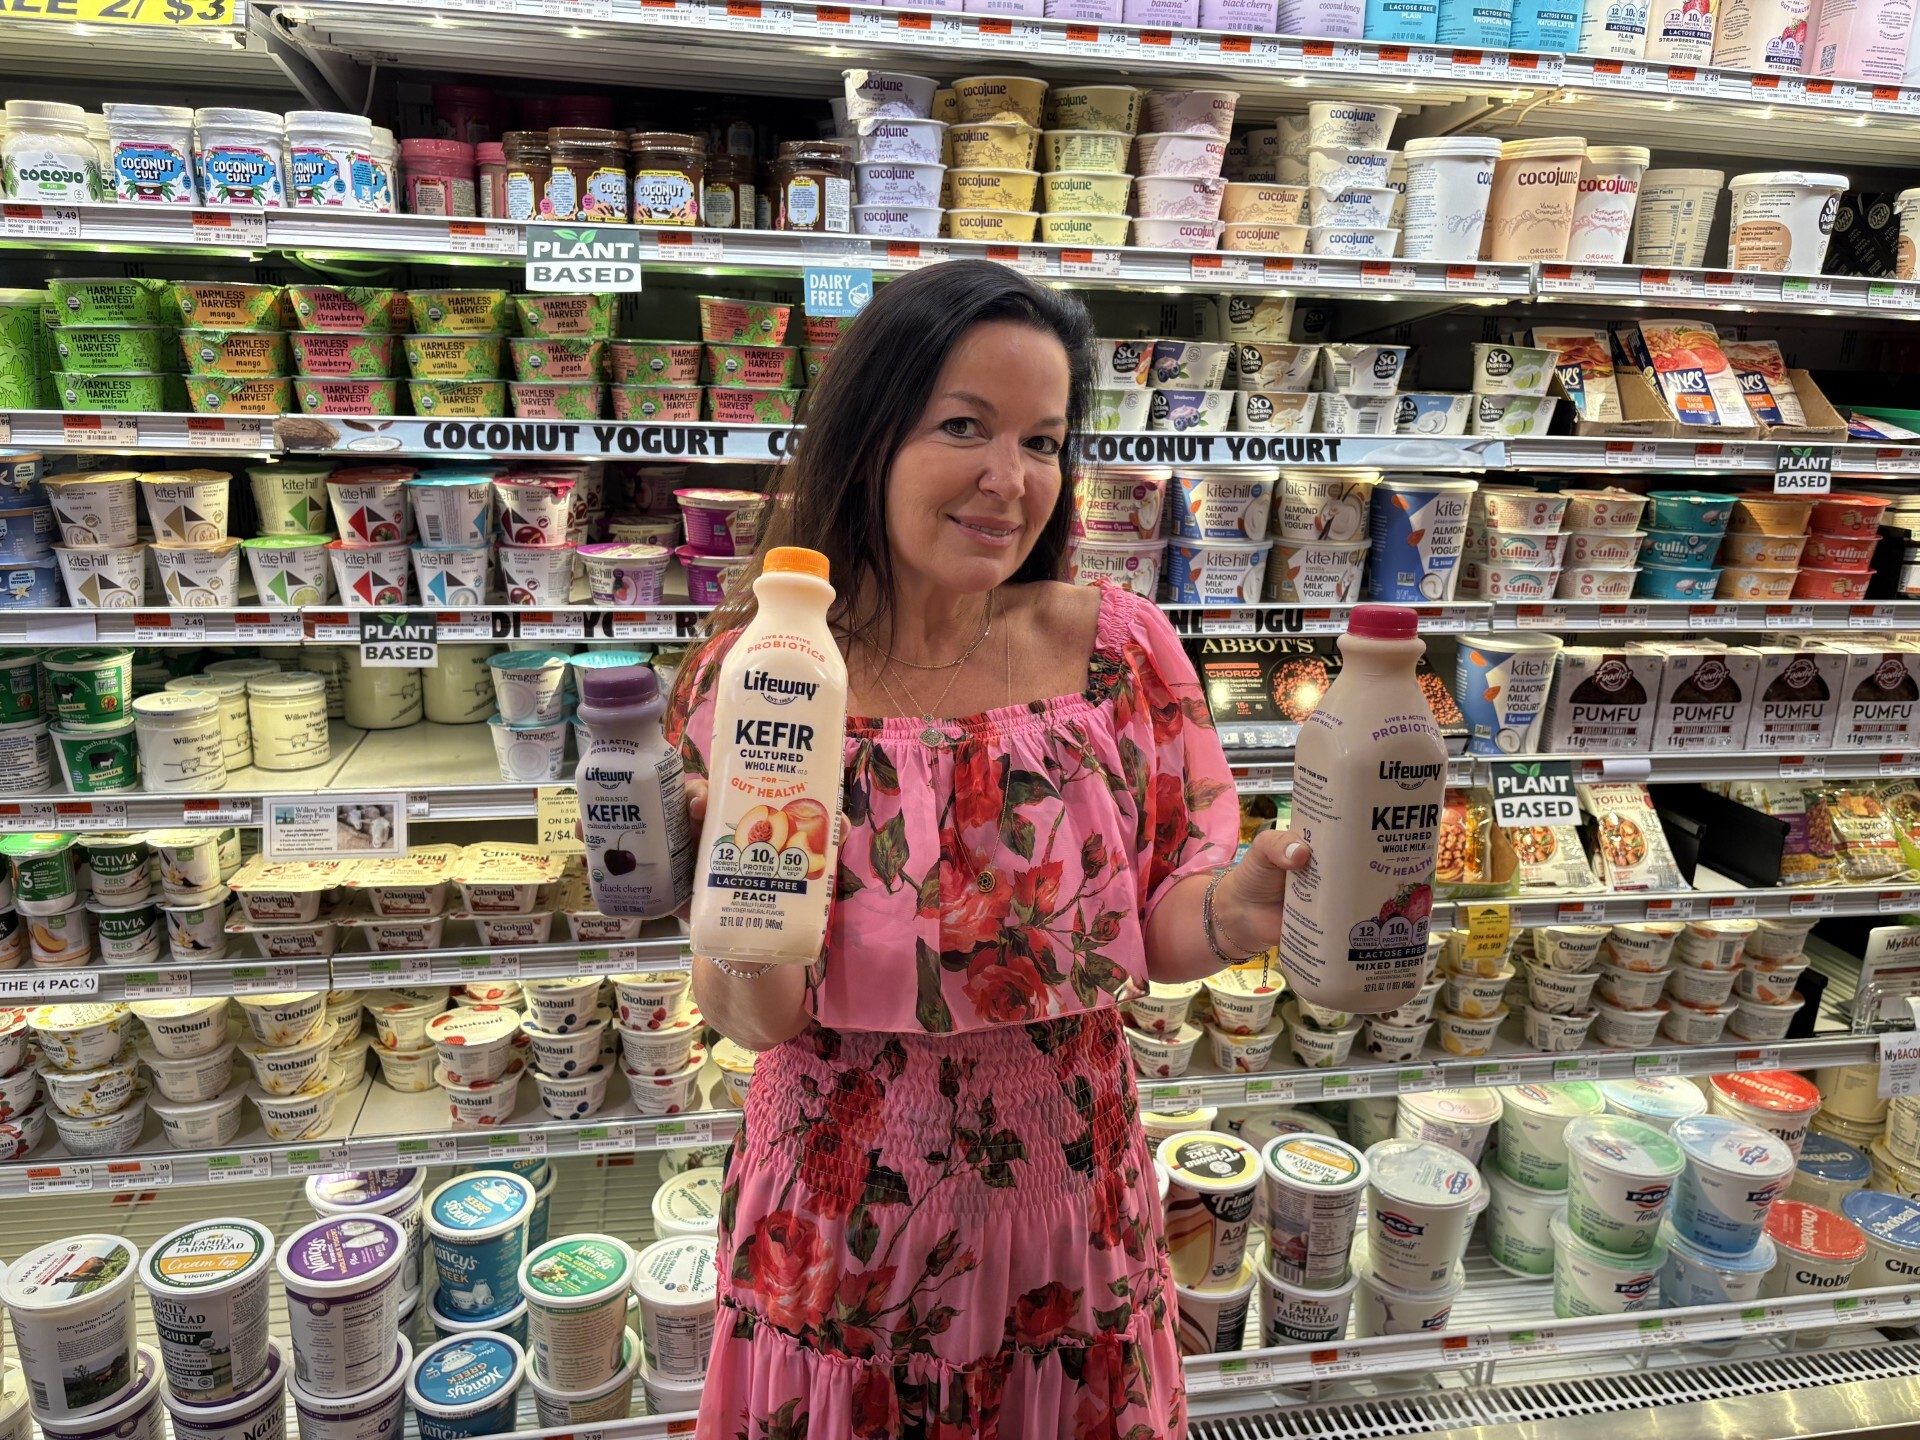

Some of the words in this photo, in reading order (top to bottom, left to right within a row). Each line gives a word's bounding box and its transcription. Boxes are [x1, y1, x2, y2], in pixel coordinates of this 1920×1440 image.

[1151, 0, 1182, 8] banana
[1252, 0, 1272, 11] cherry
[1402, 12, 1421, 20] PLAIN
[1610, 24, 1630, 32] LACTOSE
[1261, 45, 1277, 53] 7.49
[1418, 55, 1434, 63] 9.99
[963, 83, 1007, 99] cocojune
[121, 158, 174, 172] COCONUT
[213, 161, 266, 176] COCONUT
[134, 169, 161, 180] CULT
[226, 173, 252, 183] CULT
[869, 167, 914, 181] cocojune
[1517, 169, 1578, 188] cocojune
[958, 176, 1000, 189] cocojune
[1050, 180, 1092, 192] cocojune
[1577, 179, 1638, 197] cocojune
[57, 211, 77, 220] 9.49
[533, 241, 635, 259] PLANT
[533, 265, 635, 284] BASED
[809, 272, 852, 292] DAIRY
[86, 286, 137, 294] HARMLESS
[196, 290, 245, 299] HARMLESS
[92, 295, 135, 304] HARVEST
[810, 289, 843, 307] FREE
[201, 300, 242, 308] HARVEST
[543, 301, 587, 310] HARMLESS
[210, 311, 236, 319] mango
[548, 310, 584, 319] HARVEST
[304, 339, 349, 348] HARMLESS
[420, 341, 465, 350] HARMLESS
[307, 348, 346, 359] HARVEST
[425, 351, 463, 361] HARVEST
[745, 351, 785, 361] HARMLESS
[748, 360, 781, 369] HARVEST
[118, 420, 137, 428] 2.99
[241, 423, 260, 431] 2.99
[424, 421, 580, 452] COCONUT
[595, 429, 729, 457] YOGURT
[1083, 436, 1214, 463] COCONUT
[1225, 438, 1341, 462] YOGURT
[1778, 456, 1830, 471] PLANT
[1778, 475, 1828, 488] BASED
[1207, 484, 1231, 498] kite
[1233, 483, 1250, 498] hill
[1087, 501, 1119, 511] GREEK
[1285, 506, 1318, 516] ALMOND
[1284, 522, 1313, 531] YOGURT
[1499, 546, 1540, 559] culina
[564, 615, 581, 624] 2.49
[656, 612, 673, 621] 2.99
[364, 624, 435, 640] PLANT
[786, 635, 811, 645] ACTIVE
[1202, 638, 1314, 653] ABBOT'S
[365, 645, 433, 661] BASED
[747, 640, 826, 663] PROBIOTICS
[501, 671, 541, 683] Forager
[744, 670, 818, 700] Lifeway
[1508, 685, 1546, 694] ALMOND
[1508, 694, 1530, 702] MILK
[1507, 703, 1540, 712] YOGURT
[1672, 705, 1735, 721] PUMFU
[1763, 703, 1824, 719] PUMFU
[1853, 703, 1912, 719] PUMFU
[1572, 706, 1641, 722] PUMFU
[735, 719, 814, 751] KEFIR
[173, 737, 199, 746] Willow
[740, 749, 804, 763] CULTURED
[744, 761, 773, 772] WHOLE
[775, 763, 796, 774] MILK
[1379, 761, 1442, 781] Lifeway
[586, 766, 634, 784] Lifeway
[761, 776, 777, 784] FOR
[731, 778, 755, 796] GUT
[757, 782, 806, 798] HEALTH
[1497, 774, 1569, 796] PLANT
[232, 800, 251, 809] 8.99
[1594, 795, 1622, 806] TOFU
[32, 805, 52, 814] 3.49
[586, 804, 641, 822] KEFIR
[1501, 800, 1575, 819] BASED
[1371, 803, 1439, 830] KEFIR
[631, 822, 647, 830] milk
[1377, 832, 1432, 843] CULTURED
[1382, 842, 1408, 854] WHOLE
[1409, 842, 1426, 852] MILK
[90, 852, 139, 867] ACTIVIA
[718, 849, 734, 860] 12
[750, 849, 775, 864] 10g
[784, 854, 802, 865] 50
[712, 860, 738, 868] PROBIOTIC
[743, 863, 774, 872] PROTEIN
[1369, 860, 1391, 875] GUT
[1392, 856, 1432, 876] HEALTH
[103, 877, 126, 887] ZERO
[716, 877, 767, 889] LACTOSE
[770, 879, 798, 891] FREE
[600, 884, 620, 894] black
[622, 884, 652, 894] cherry
[733, 891, 776, 902] PEACH
[618, 950, 635, 958] 2.99
[1358, 950, 1402, 959] LACTOSE
[1356, 961, 1393, 970] MIXED
[1395, 957, 1425, 968] BERRY
[170, 973, 188, 982] 3.99
[0, 981, 30, 994] THE
[33, 978, 45, 993] (4
[49, 975, 96, 991] PACK)
[1534, 978, 1576, 994] Chobani
[531, 998, 574, 1009] Chobani
[621, 995, 664, 1006] Chobani
[157, 1016, 213, 1035] Chobani
[1451, 1026, 1492, 1037] Chobani
[1294, 1033, 1334, 1049] Chobani
[1885, 1049, 1920, 1062] MyBACO
[267, 1055, 318, 1072] Chobani
[72, 1167, 90, 1175] 1.99
[176, 1243, 244, 1253] FARMSTEAD
[167, 1260, 213, 1271] Cream
[218, 1256, 238, 1267] Top
[1288, 1303, 1329, 1316] FAMILY
[1277, 1311, 1338, 1324] FARMSTEAD
[1284, 1327, 1330, 1341] YOGURT
